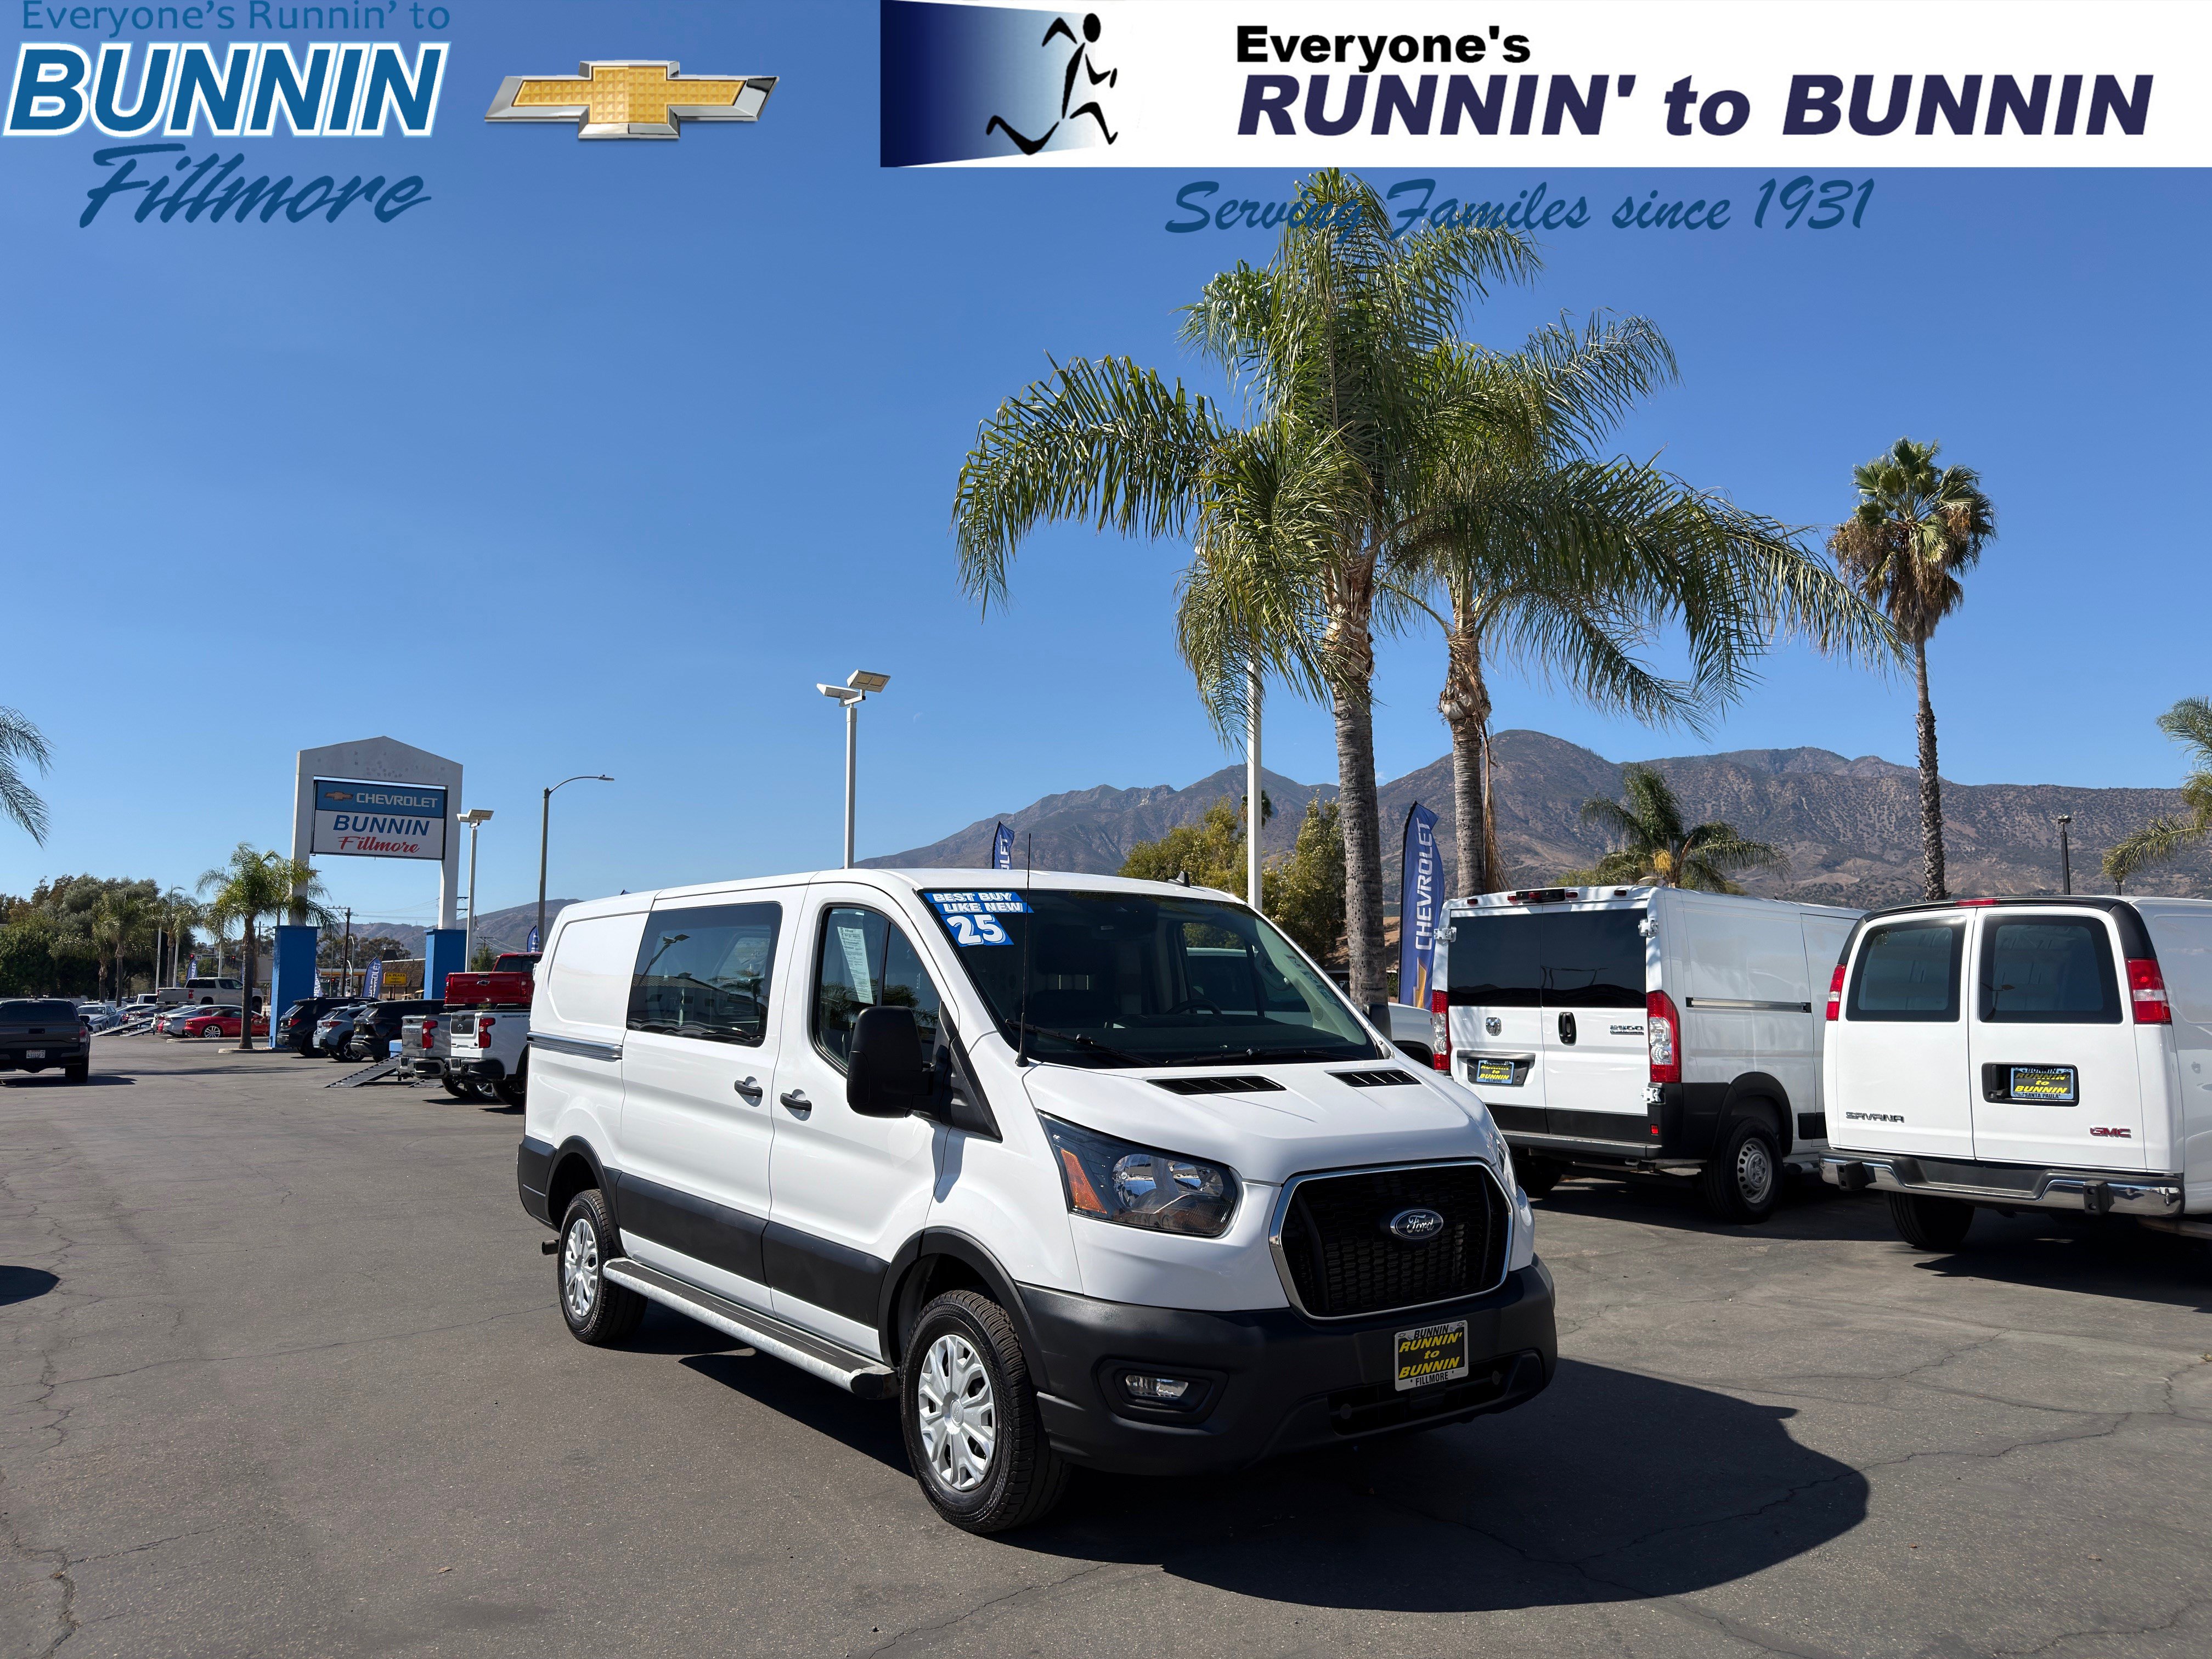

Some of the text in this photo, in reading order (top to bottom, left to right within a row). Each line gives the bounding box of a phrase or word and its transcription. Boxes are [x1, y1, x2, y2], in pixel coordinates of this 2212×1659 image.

[356, 793, 438, 808] CHEVROLET
[333, 815, 430, 836] BUNNIN
[337, 836, 420, 854] Fillmore
[1000, 834, 1009, 870] LET
[1415, 817, 1433, 951] CHEVROLET
[933, 892, 1012, 902] BEST BUY
[943, 902, 1023, 913] LIKE NEW
[946, 915, 1006, 945] 25
[2015, 1085, 2068, 1093] BUNNIN
[1846, 1111, 1905, 1123] SAVANA
[2090, 1127, 2132, 1138] GMC
[1406, 1214, 1435, 1233] Ford
[1414, 1324, 1450, 1339] BUNNIN
[1399, 1332, 1463, 1353] RUNNIN'
[1424, 1350, 1440, 1359] to
[1398, 1356, 1460, 1379] BUNNIN
[1415, 1372, 1448, 1386] FILLMORE
